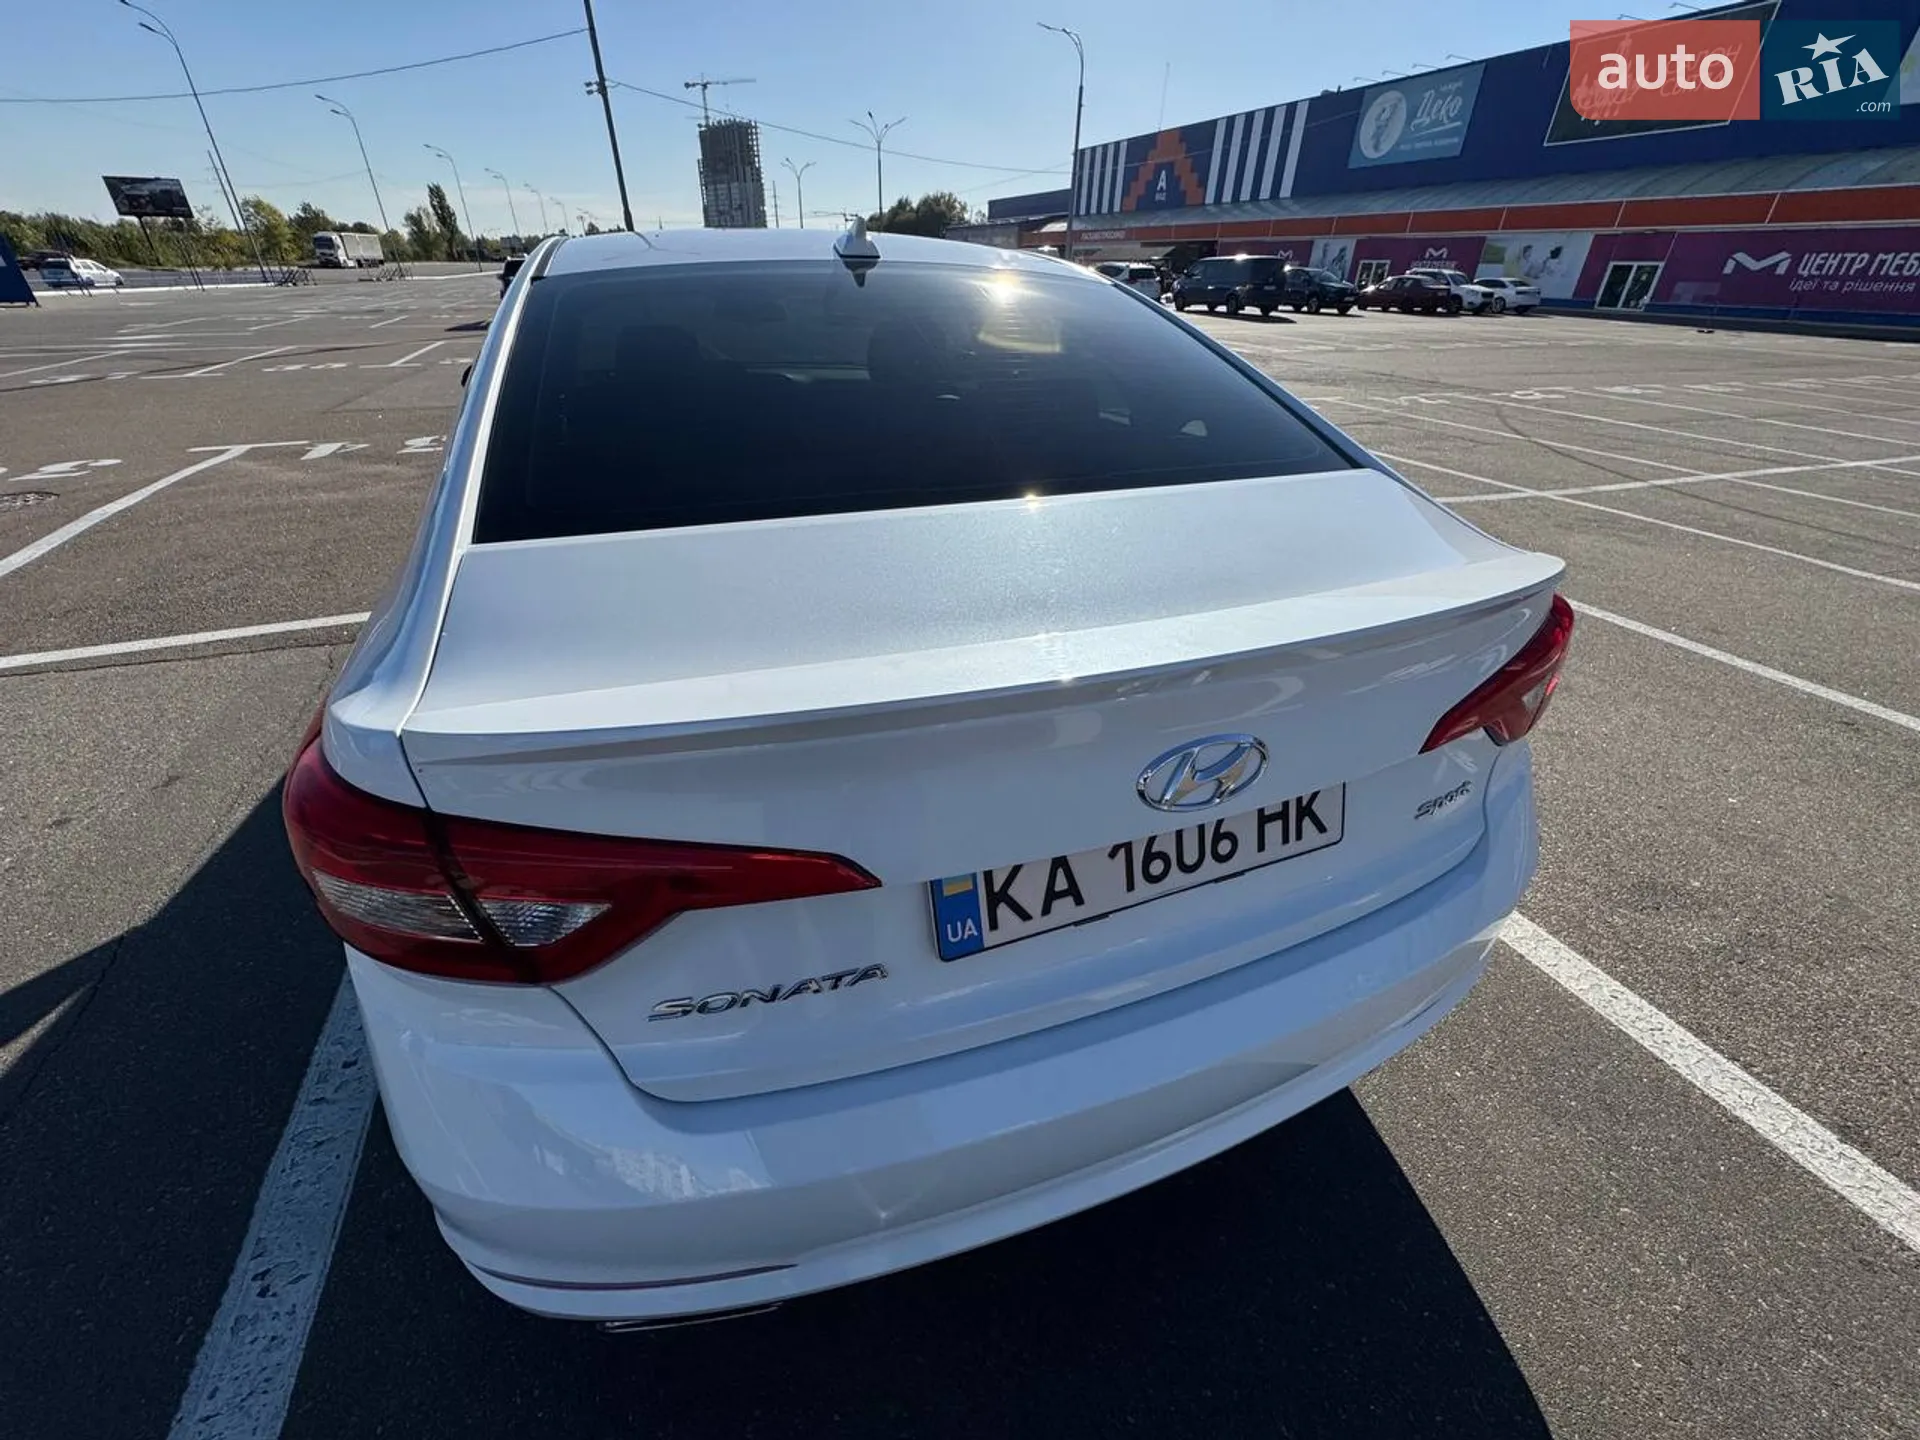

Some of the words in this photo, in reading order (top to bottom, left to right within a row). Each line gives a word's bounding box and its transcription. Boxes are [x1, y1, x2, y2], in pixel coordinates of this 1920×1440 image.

[1797, 252, 1870, 277] ЦЕНТР
[1823, 280, 1840, 292] та
[1841, 279, 1917, 295] рішення
[982, 855, 1086, 932] KA
[1256, 790, 1329, 853] HK
[946, 917, 978, 944] UA
[647, 963, 889, 1022] SONATA
